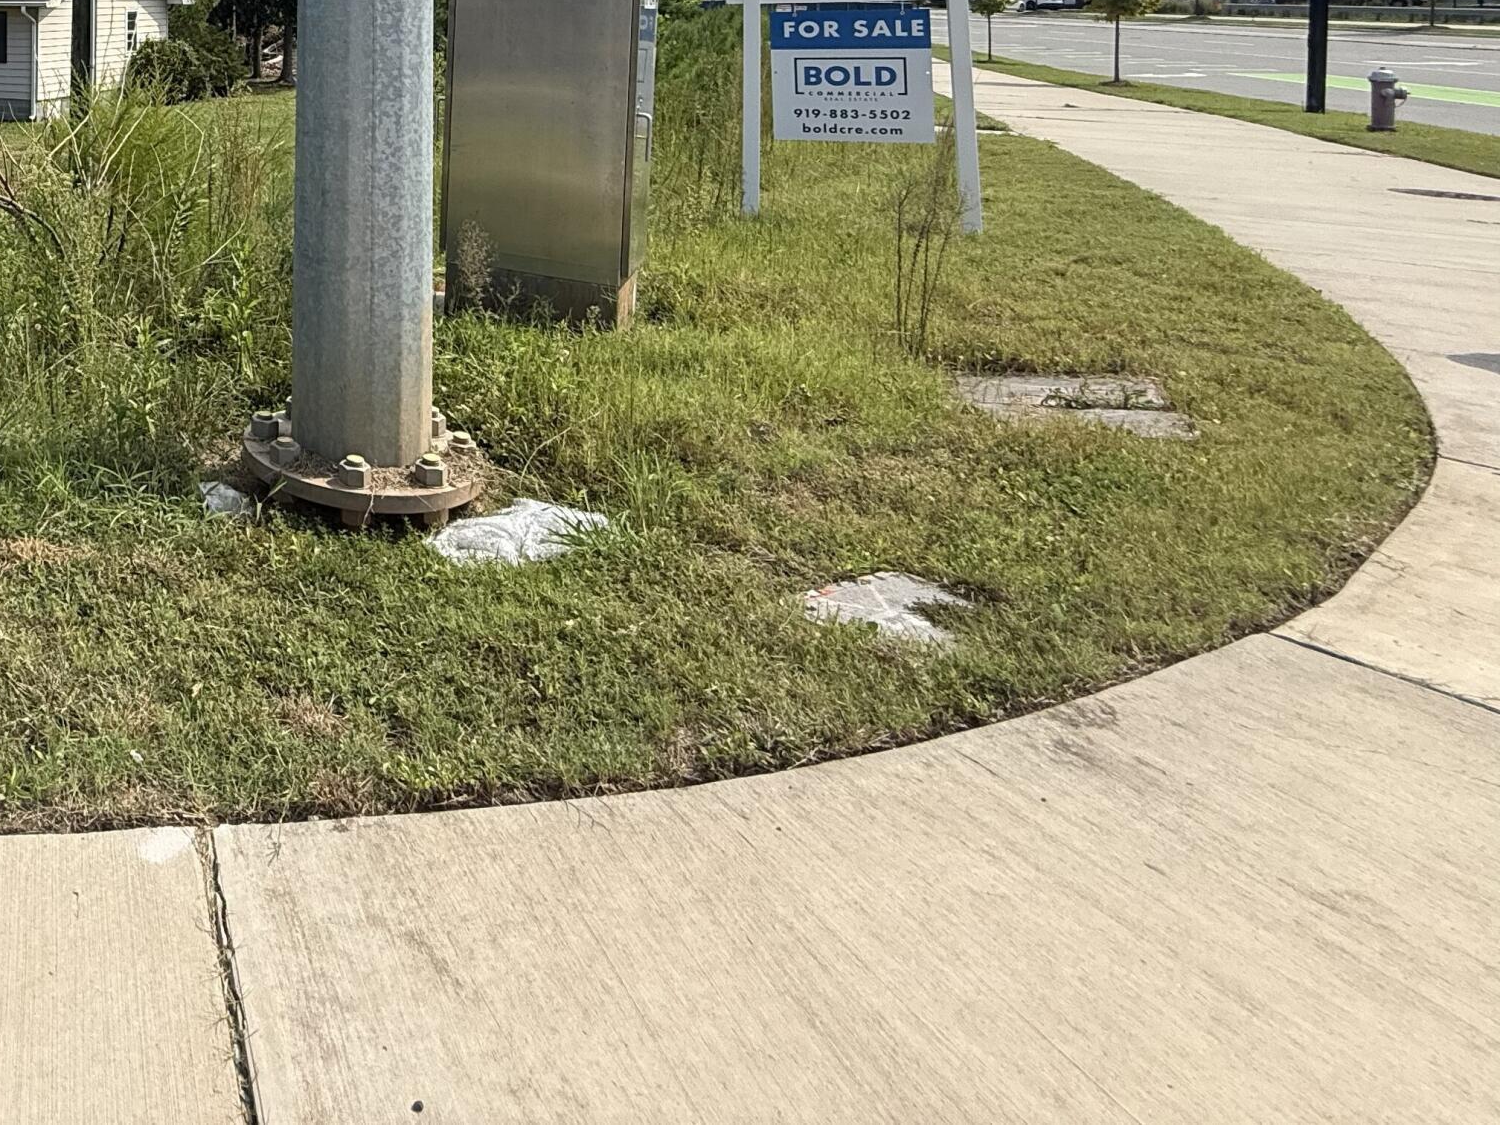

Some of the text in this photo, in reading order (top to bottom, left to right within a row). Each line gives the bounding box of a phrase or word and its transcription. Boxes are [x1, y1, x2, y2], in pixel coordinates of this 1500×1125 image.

[783, 19, 924, 38] FOR SALE
[804, 65, 897, 86] BOLD
[793, 108, 911, 120] 919-883-5502
[802, 123, 903, 135] boldcre.com
